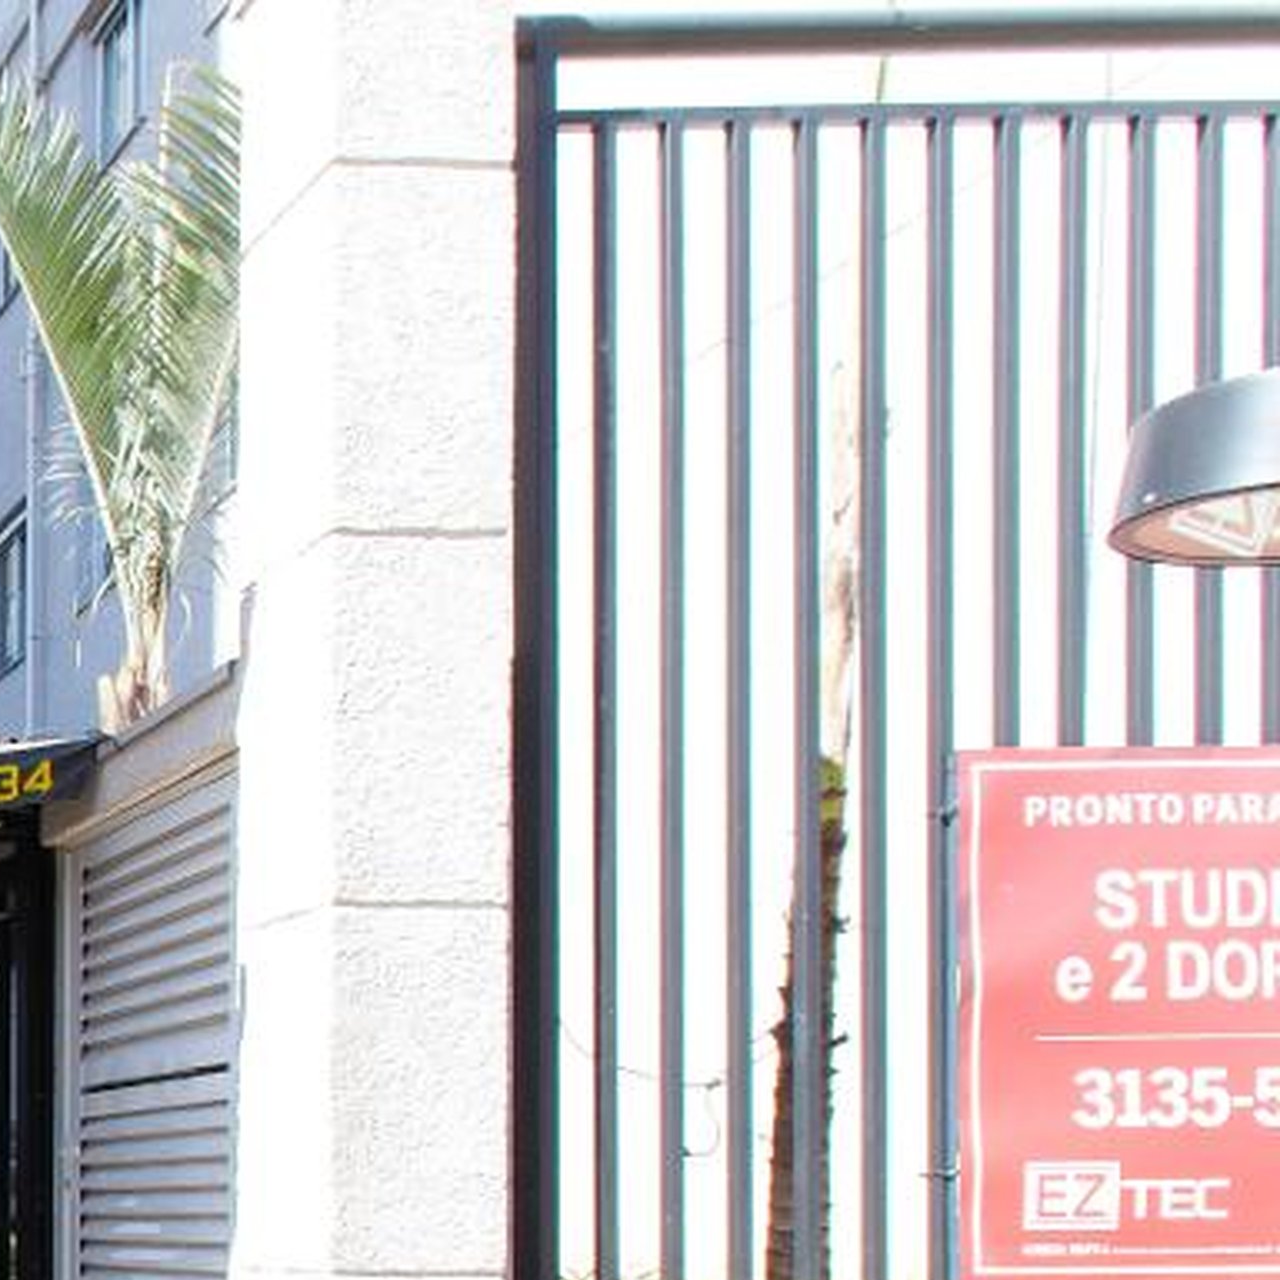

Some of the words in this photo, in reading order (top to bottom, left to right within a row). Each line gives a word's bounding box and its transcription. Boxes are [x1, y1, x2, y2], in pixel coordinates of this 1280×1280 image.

[1022, 792, 1186, 829] PRONTO
[1054, 954, 1094, 1004] e
[1107, 938, 1149, 1001] 2
